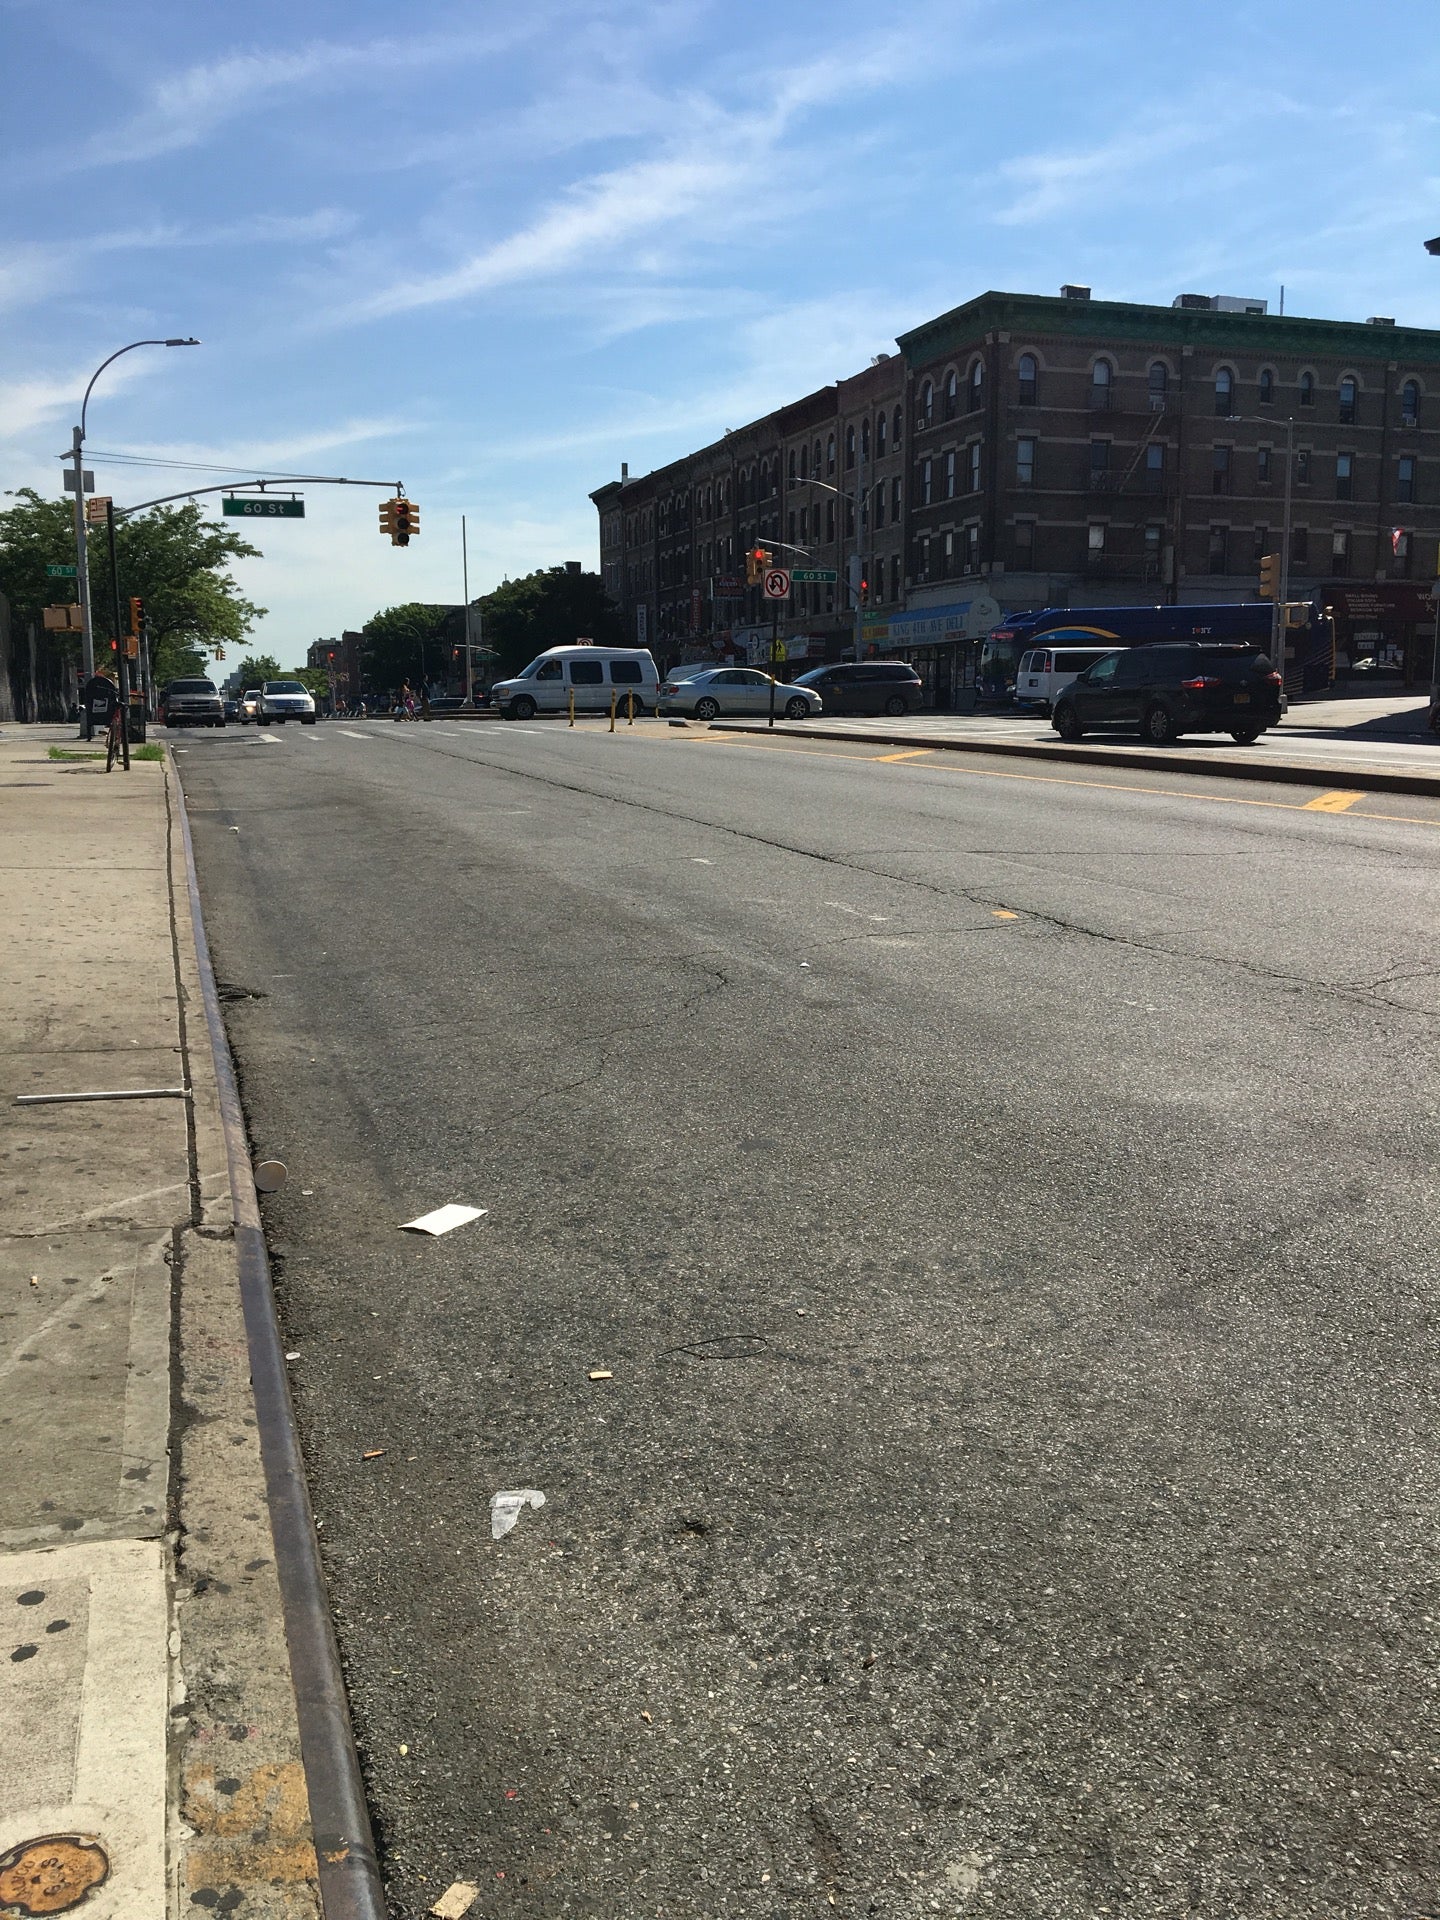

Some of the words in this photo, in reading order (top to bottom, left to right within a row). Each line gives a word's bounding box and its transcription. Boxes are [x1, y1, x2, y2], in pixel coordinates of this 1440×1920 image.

[243, 503, 262, 513] 60
[268, 503, 284, 514] St
[51, 567, 62, 575] 60
[803, 572, 815, 580] 60
[817, 572, 827, 580] St
[931, 619, 943, 633] AVE
[946, 616, 963, 631] DELI
